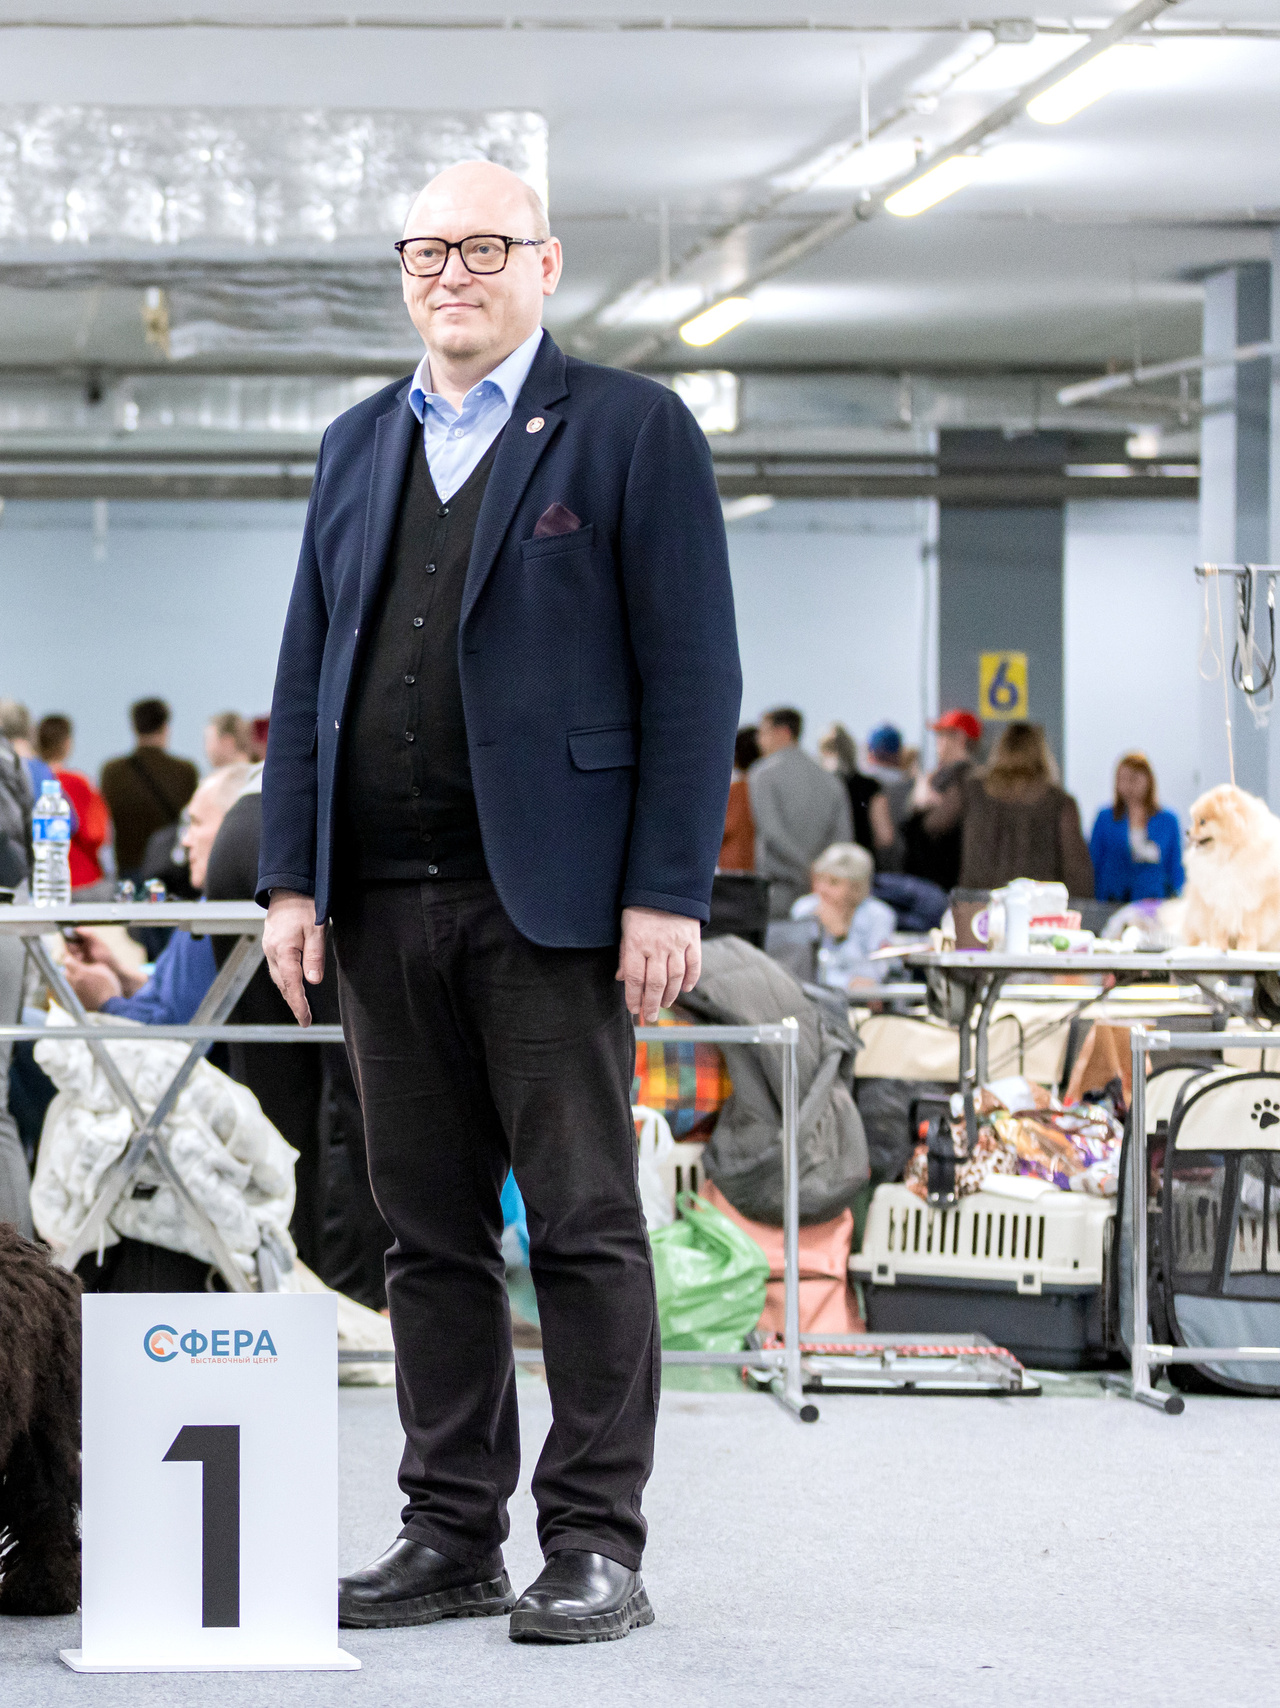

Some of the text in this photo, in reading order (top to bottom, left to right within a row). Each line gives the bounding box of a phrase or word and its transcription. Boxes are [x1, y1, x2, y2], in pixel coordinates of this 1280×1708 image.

[988, 662, 1019, 712] 6
[143, 1324, 277, 1362] СФЕРА
[190, 1356, 278, 1365] ВЫСТАВОЧНЫЙ ЦЕНТР
[161, 1424, 240, 1628] 1
